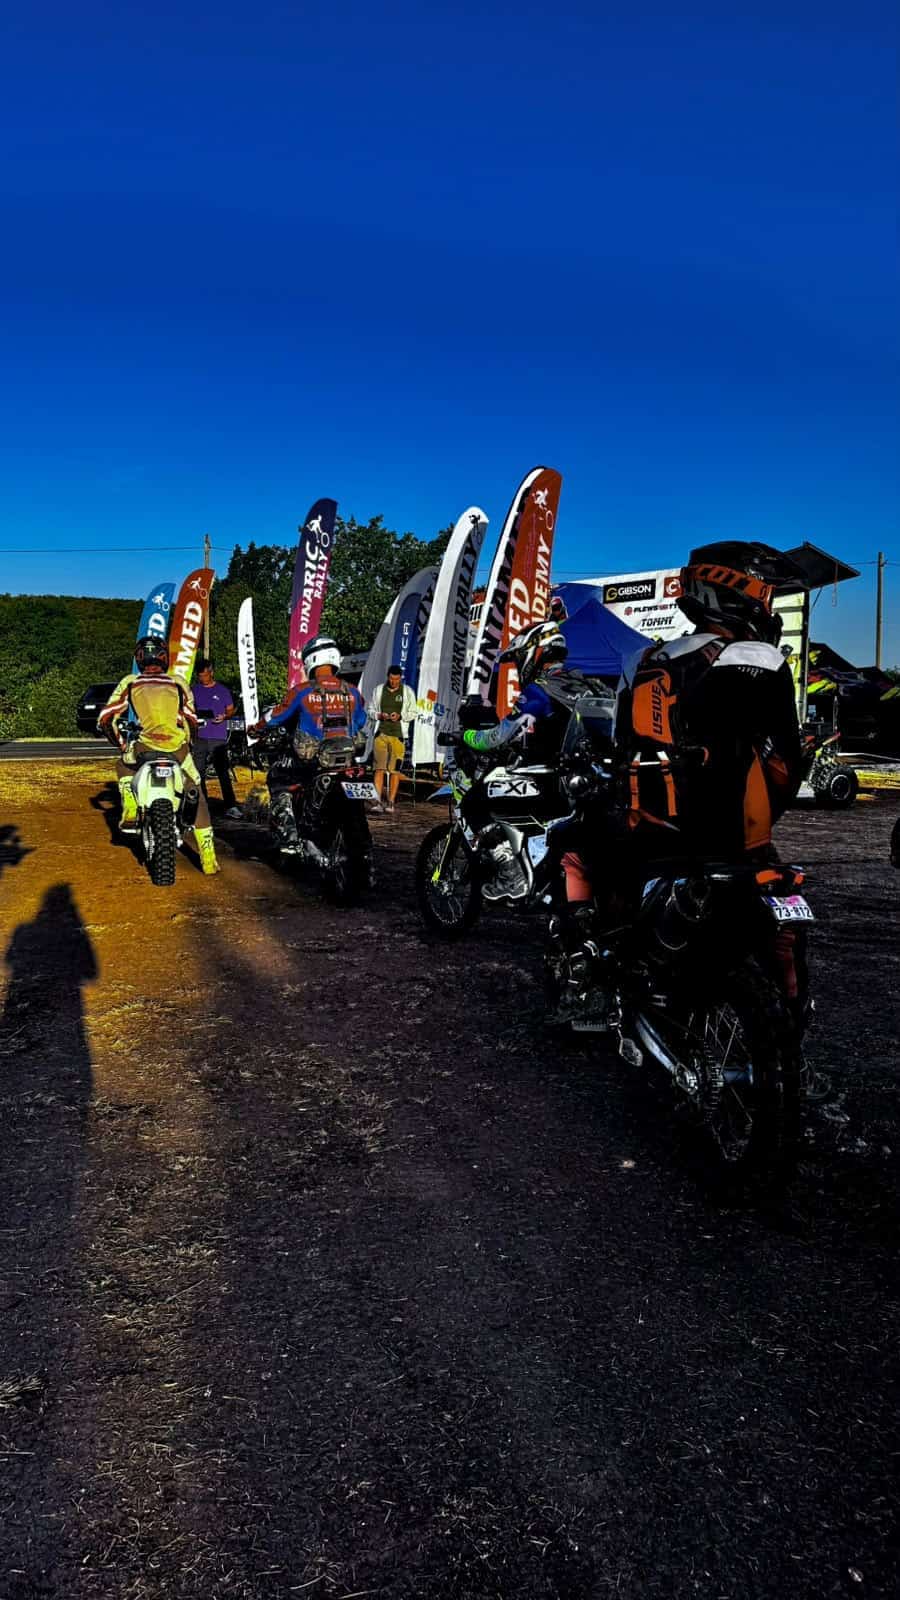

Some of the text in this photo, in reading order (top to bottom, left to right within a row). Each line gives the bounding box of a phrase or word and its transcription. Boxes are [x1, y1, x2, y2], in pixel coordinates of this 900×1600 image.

[300, 541, 319, 634] DINARIC
[314, 547, 328, 599] RALLY
[618, 584, 652, 596] GIBSON
[450, 533, 477, 695] DINARIC RALLY
[652, 686, 664, 735] USWE
